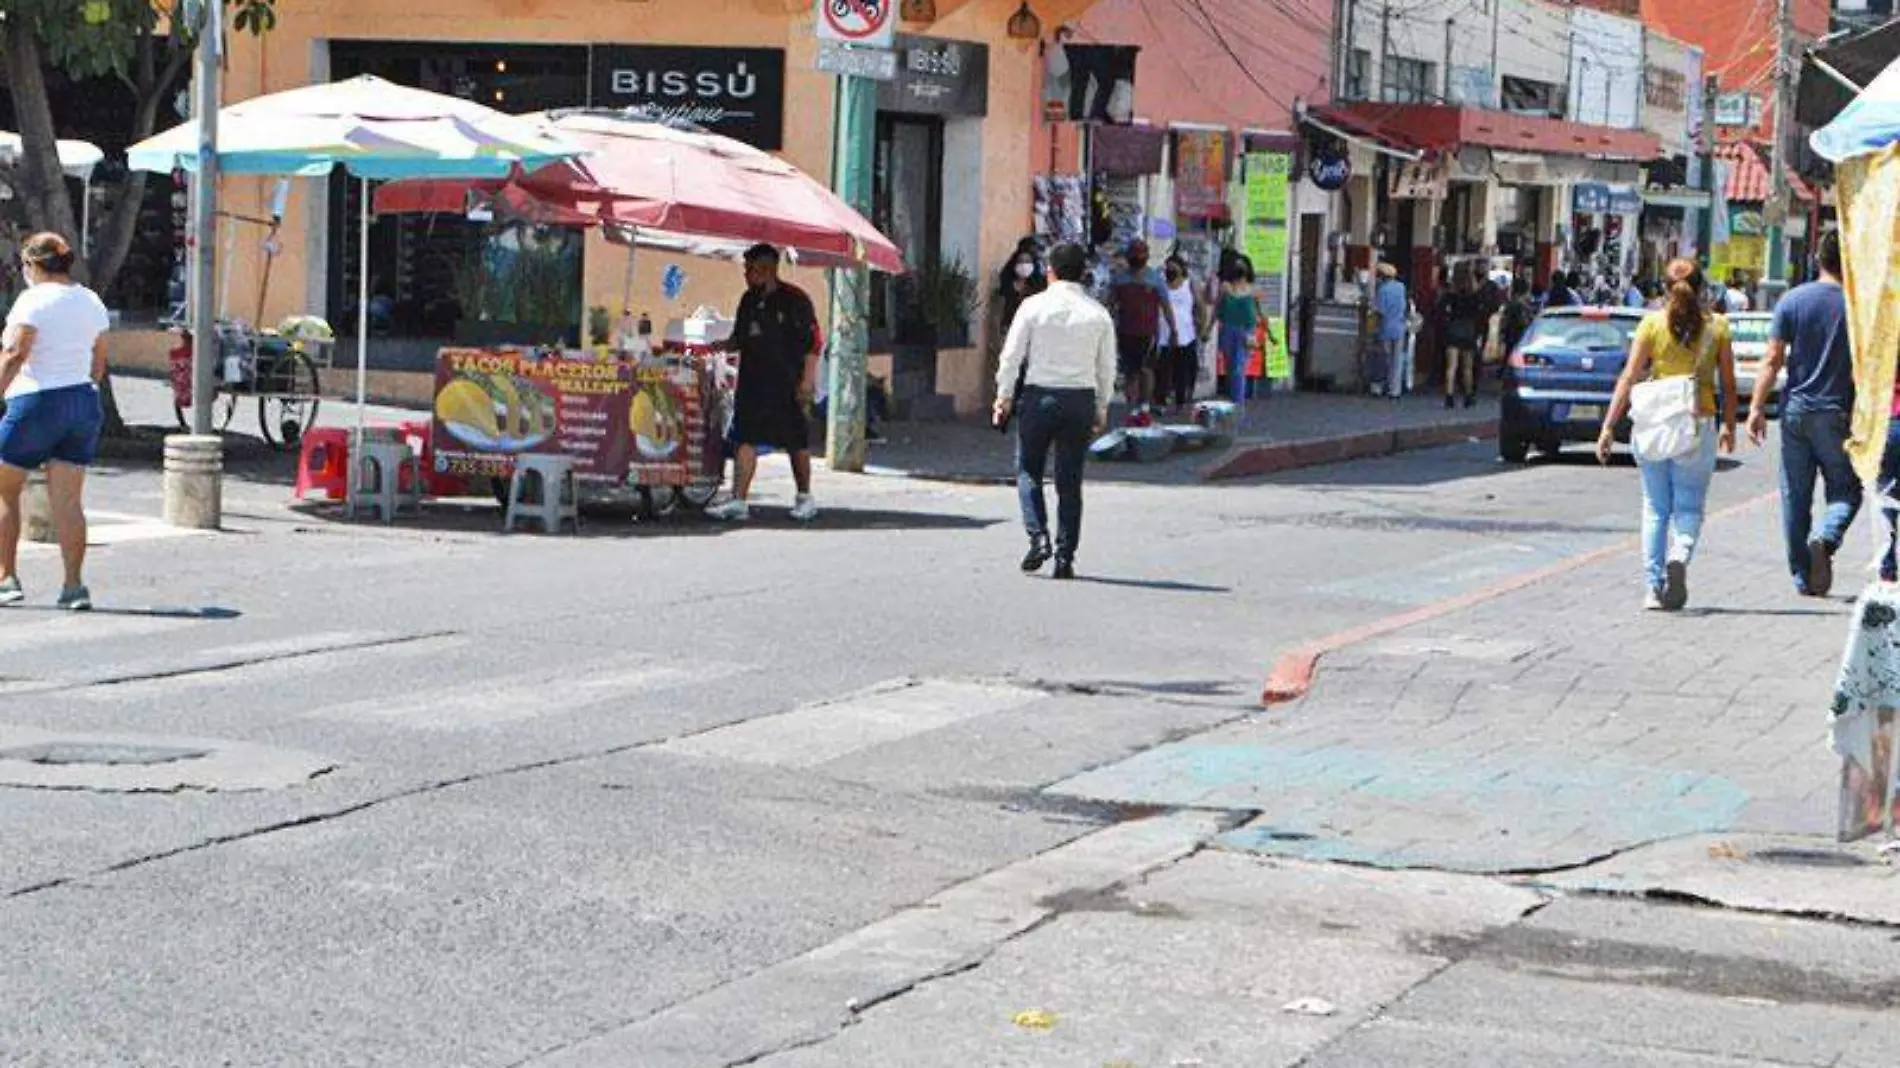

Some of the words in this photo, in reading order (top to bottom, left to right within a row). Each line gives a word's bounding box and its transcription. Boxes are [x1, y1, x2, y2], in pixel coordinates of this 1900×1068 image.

[611, 60, 757, 99] BISSÚ
[450, 354, 515, 375] TACOS
[520, 360, 618, 380] PLACEROS
